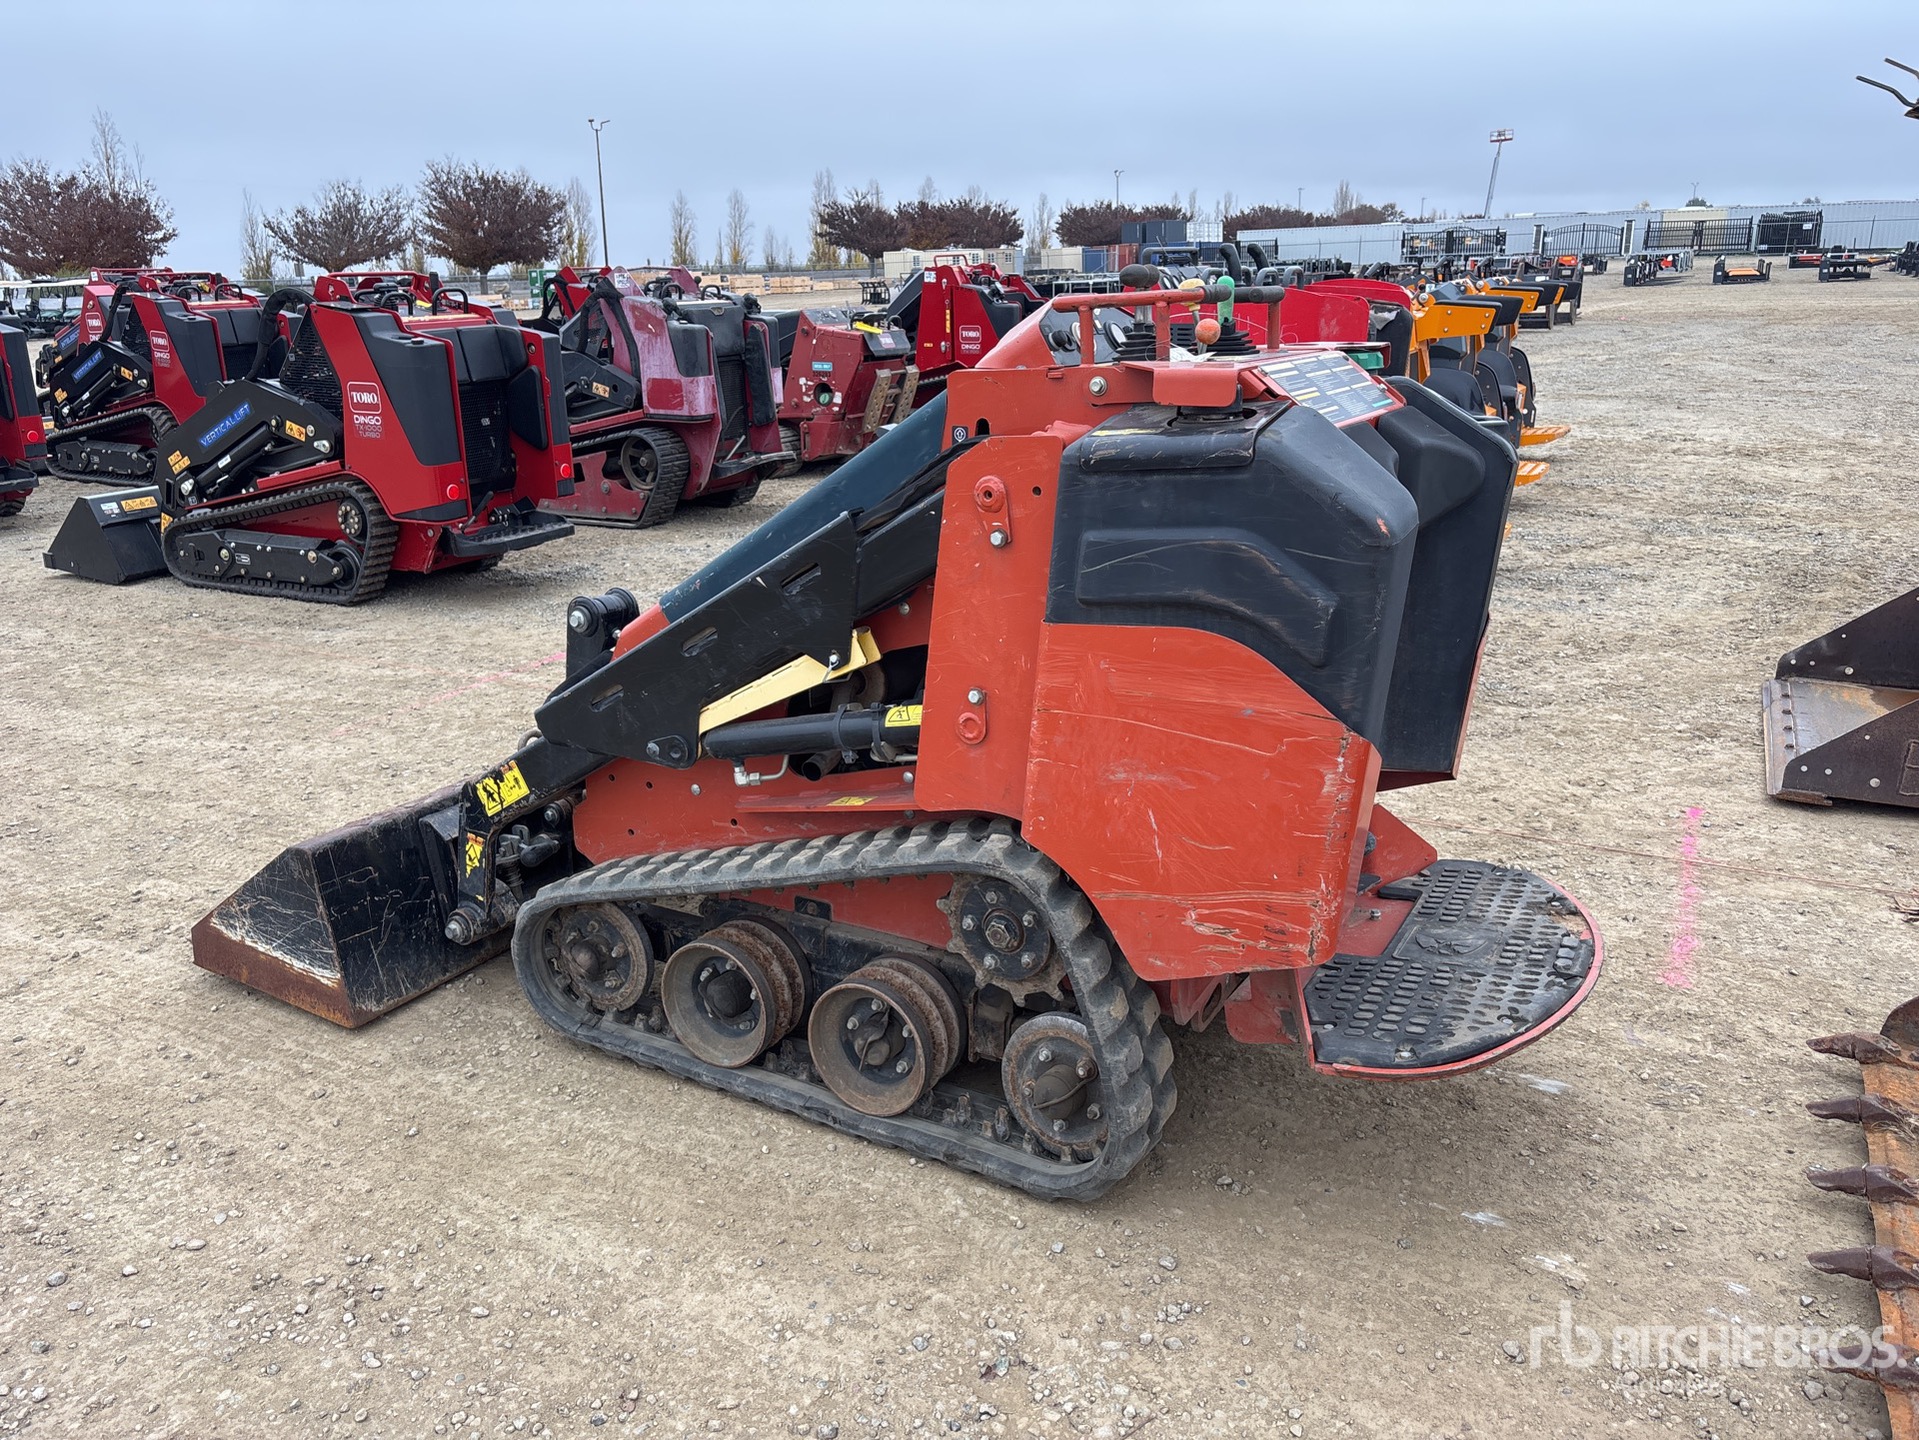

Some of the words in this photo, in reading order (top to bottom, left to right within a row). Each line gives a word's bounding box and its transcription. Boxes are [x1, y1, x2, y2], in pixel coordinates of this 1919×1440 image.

[152, 337, 167, 346] TORO
[154, 351, 170, 360] DINGO
[351, 391, 378, 404] TORO
[200, 417, 236, 446] VERTICAL
[235, 403, 250, 420] LIFT
[353, 414, 382, 425] DINGO
[359, 430, 381, 438] TURBO
